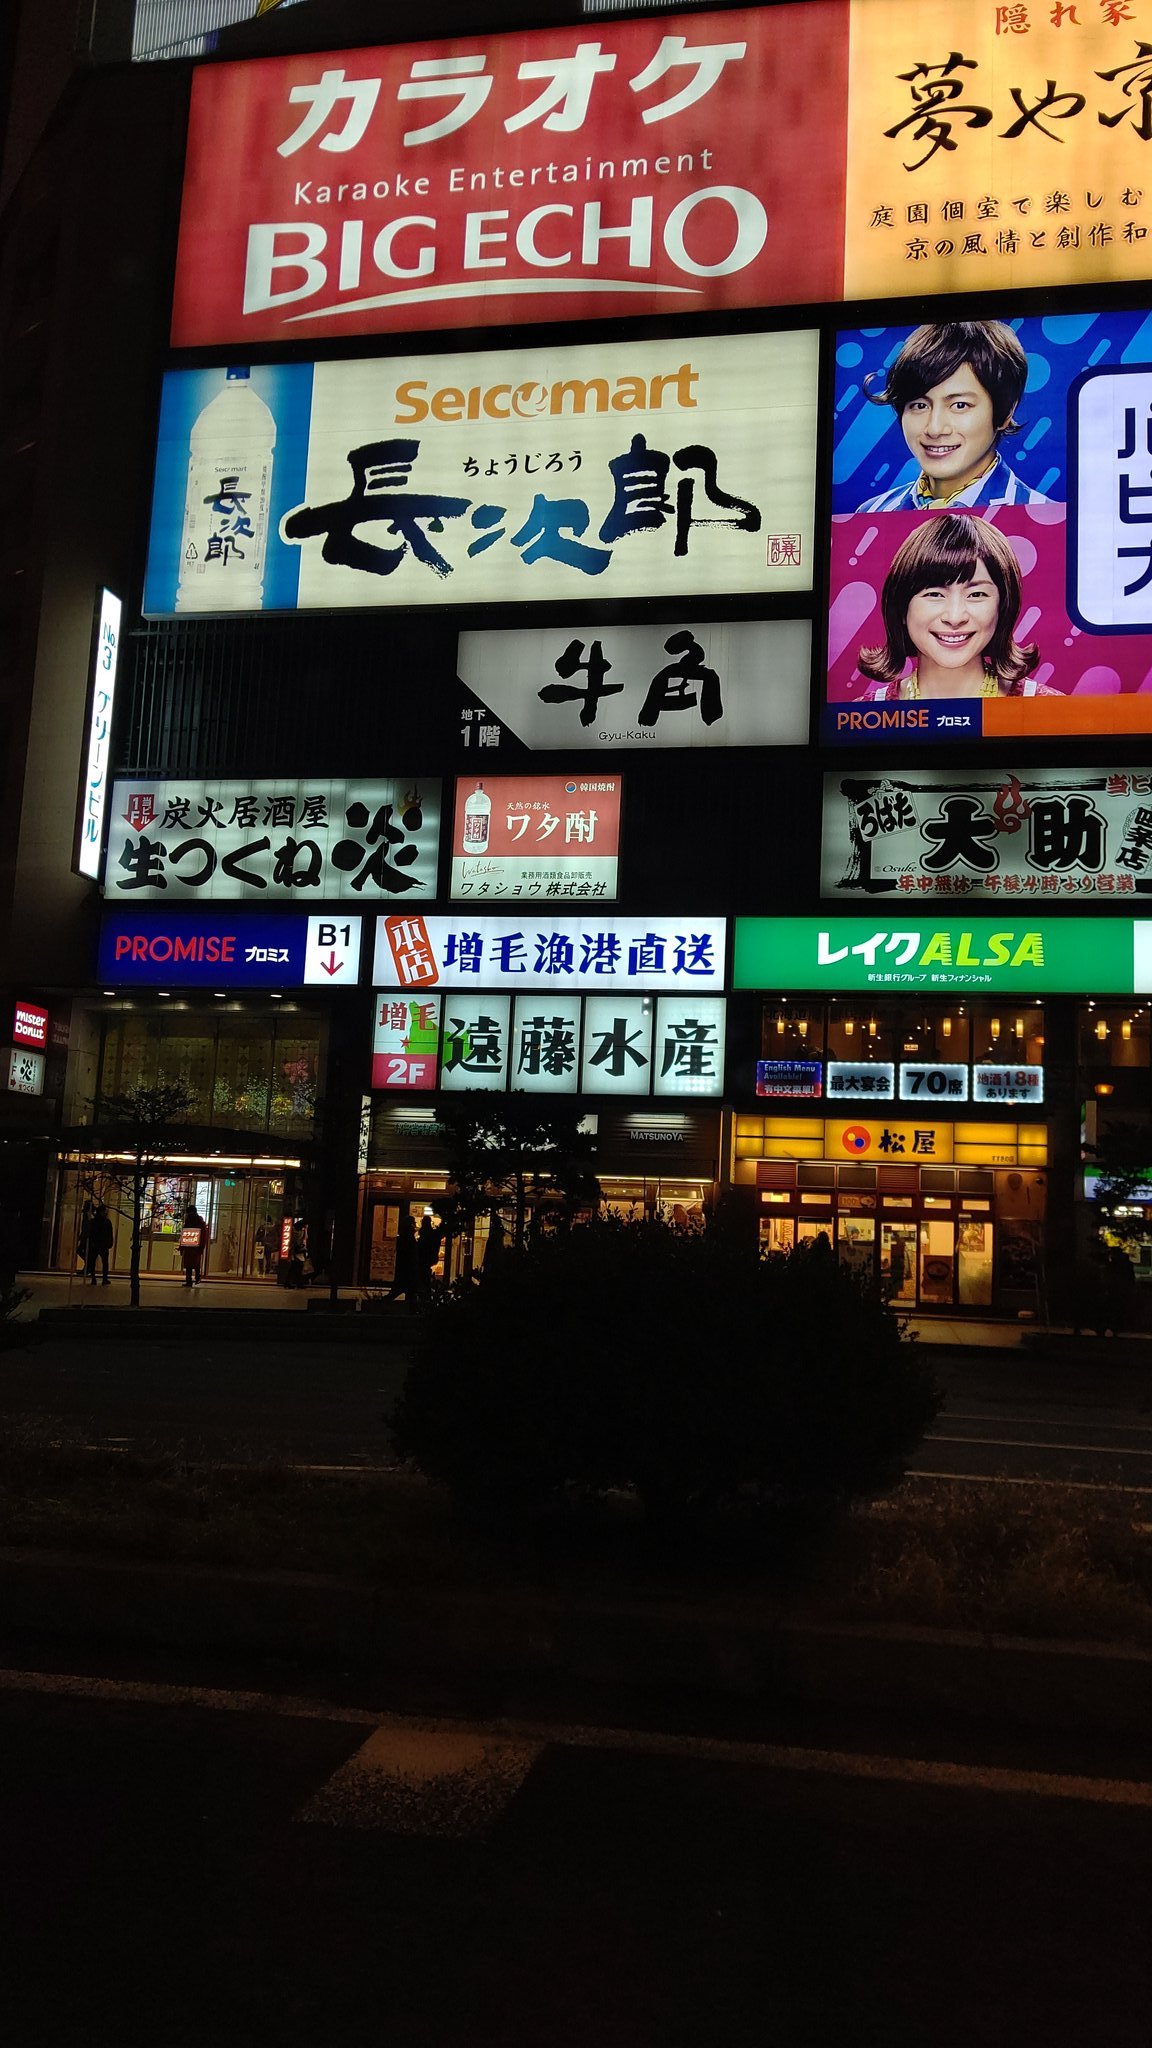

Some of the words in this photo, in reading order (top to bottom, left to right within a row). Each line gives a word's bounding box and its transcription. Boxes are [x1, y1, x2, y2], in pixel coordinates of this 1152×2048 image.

[276, 35, 747, 158] カラオケ
[294, 174, 430, 205] Karaoke
[448, 148, 713, 193] Entertainment
[868, 187, 1143, 229] 庭園個室で楽しむ
[242, 214, 437, 316] BIG
[463, 185, 768, 278] ECHO
[905, 221, 1149, 261] 京の風情と創作和
[394, 363, 700, 424] Seicomart
[462, 450, 583, 477] ちょうじろう
[203, 476, 255, 566] 長次郎
[284, 433, 763, 580] 長次郎
[538, 630, 724, 728] 牛角
[461, 709, 486, 721] 地下
[837, 709, 929, 731] PROMISE
[937, 715, 971, 727] プロミス
[461, 725, 500, 748] 1階
[598, 730, 656, 742] Gyu-Kaku
[130, 796, 140, 824] 1F
[141, 796, 152, 825] 当ビル
[159, 795, 329, 830] 炭火居酒屋
[856, 792, 917, 837] ろばた
[505, 809, 599, 844] ワタ酎
[920, 794, 1107, 873] 大助
[116, 836, 323, 890] 生つくね
[882, 862, 917, 873] Osuke
[460, 882, 541, 896] ワタショウ
[546, 881, 607, 896] 株式会社
[115, 935, 237, 962] PROMISE
[317, 923, 352, 947] B1
[817, 932, 921, 966] レイク
[918, 932, 1045, 967] ALSA
[244, 945, 290, 963] プロミス
[390, 918, 433, 985] 本店
[442, 931, 716, 976] 増毛漁港直送
[867, 973, 927, 983] 新生銀行グループ
[931, 973, 992, 983] 新生フィナンシャル
[378, 1001, 438, 1032] 増毛
[444, 1015, 719, 1078] 遠藤水産
[385, 1057, 426, 1085] 2F
[831, 1075, 890, 1092] 最大宴会
[906, 1071, 962, 1095] 70席
[977, 1071, 1039, 1086] 地酒18種
[986, 1088, 1030, 1099] あります
[878, 1129, 936, 1154] 松屋
